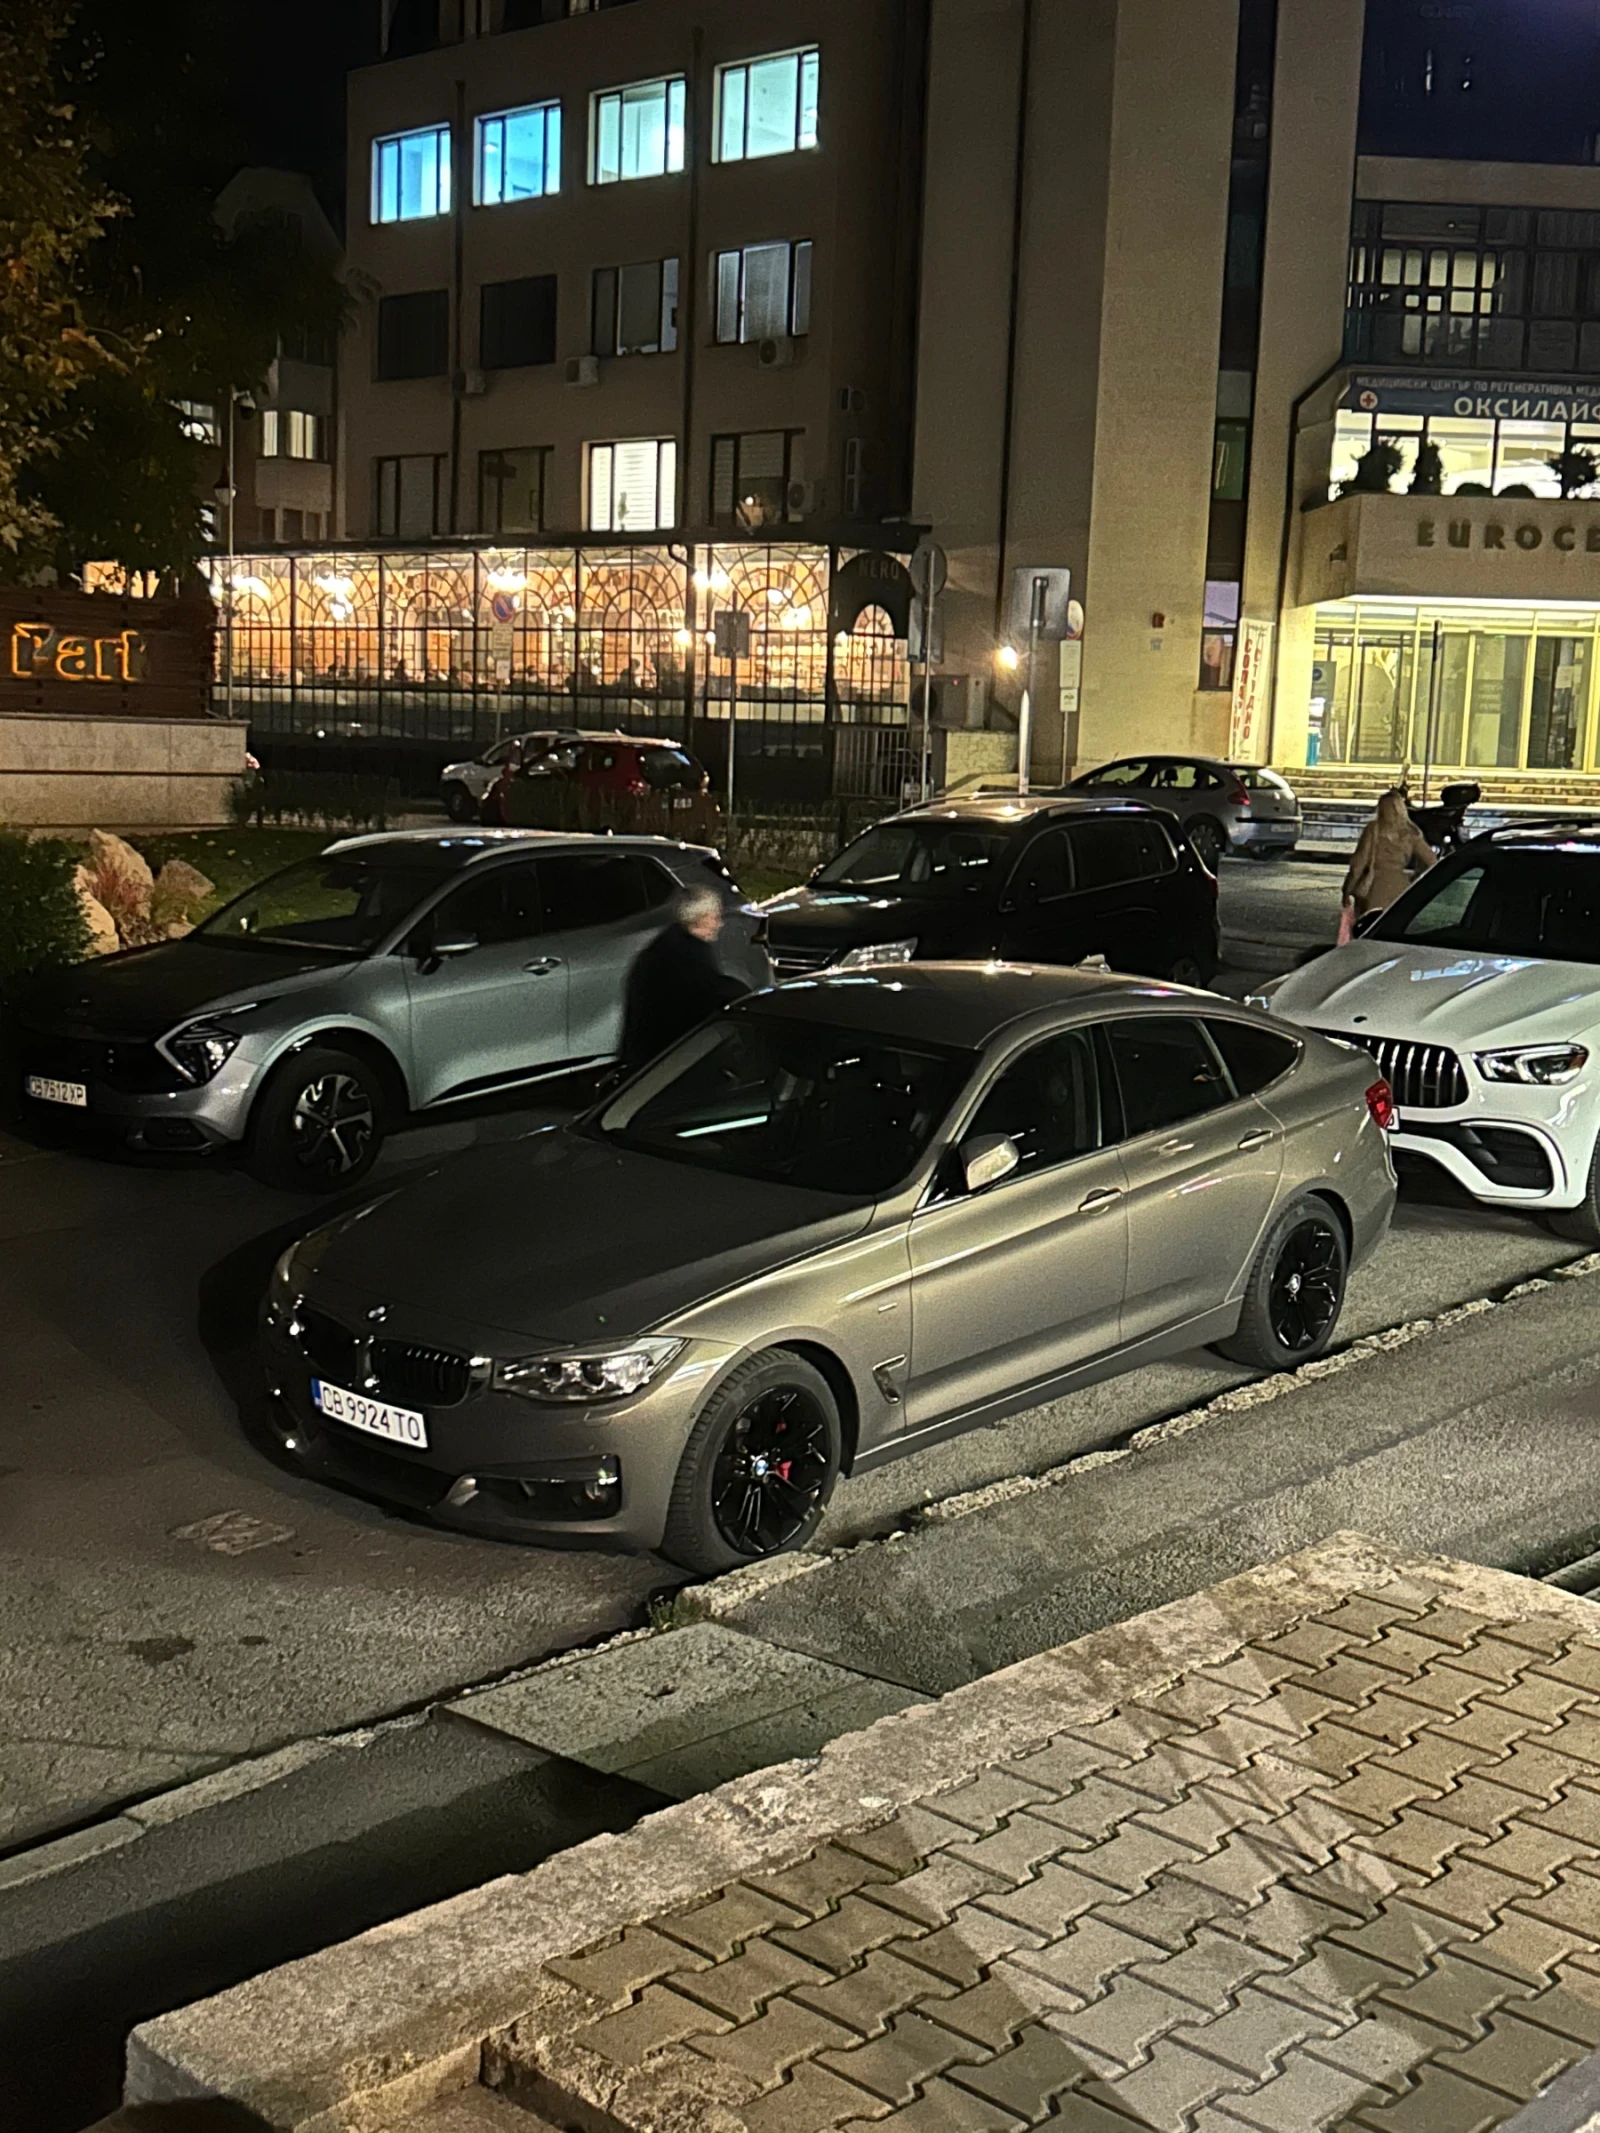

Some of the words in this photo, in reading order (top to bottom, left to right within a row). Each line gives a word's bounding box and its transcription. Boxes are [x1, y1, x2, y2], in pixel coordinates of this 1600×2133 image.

[1430, 379, 1471, 391] ЦЕНТЪР
[1473, 380, 1488, 392] ПО
[1576, 384, 1600, 397] МЕД
[859, 559, 899, 579] NERO
[346, 1397, 390, 1434] 9924
